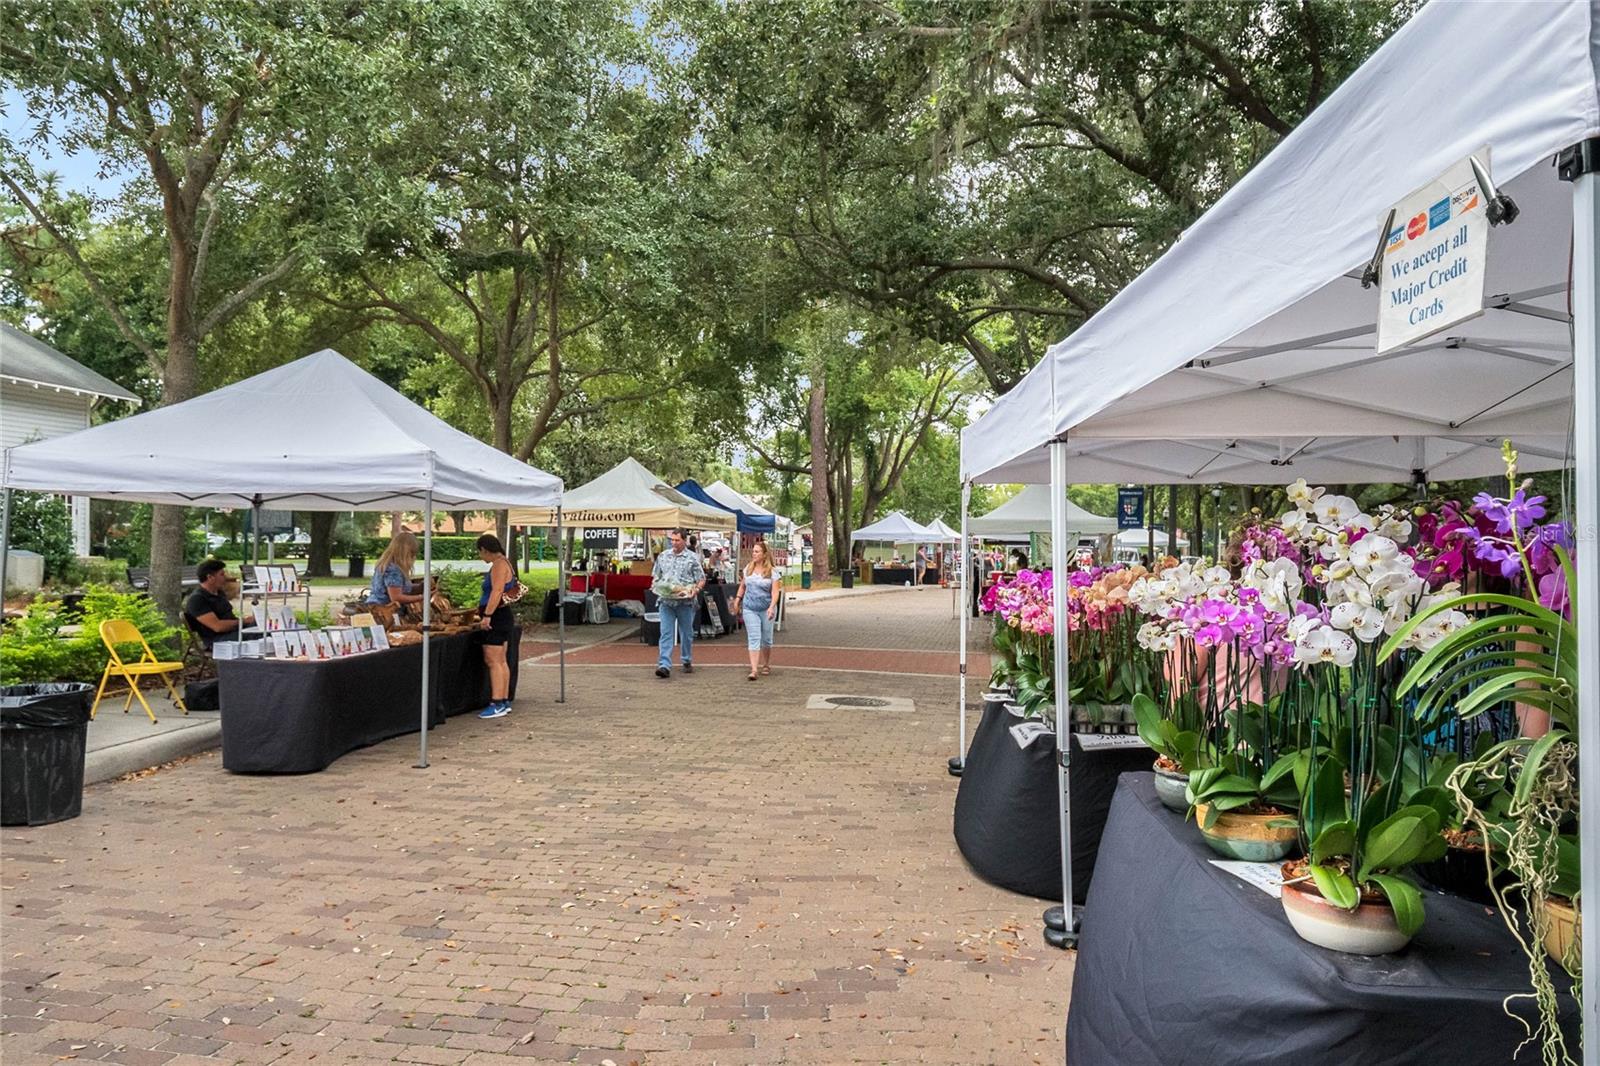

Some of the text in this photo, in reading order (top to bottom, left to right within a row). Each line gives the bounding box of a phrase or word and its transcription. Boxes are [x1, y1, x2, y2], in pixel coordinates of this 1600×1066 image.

[1453, 186, 1476, 205] DISCOVER
[1391, 260, 1410, 279] We
[1412, 239, 1449, 270] accept
[1452, 225, 1468, 249] all
[1391, 257, 1468, 308] Major Credit
[1409, 298, 1444, 325] Cards
[584, 528, 617, 539] COFFEE
